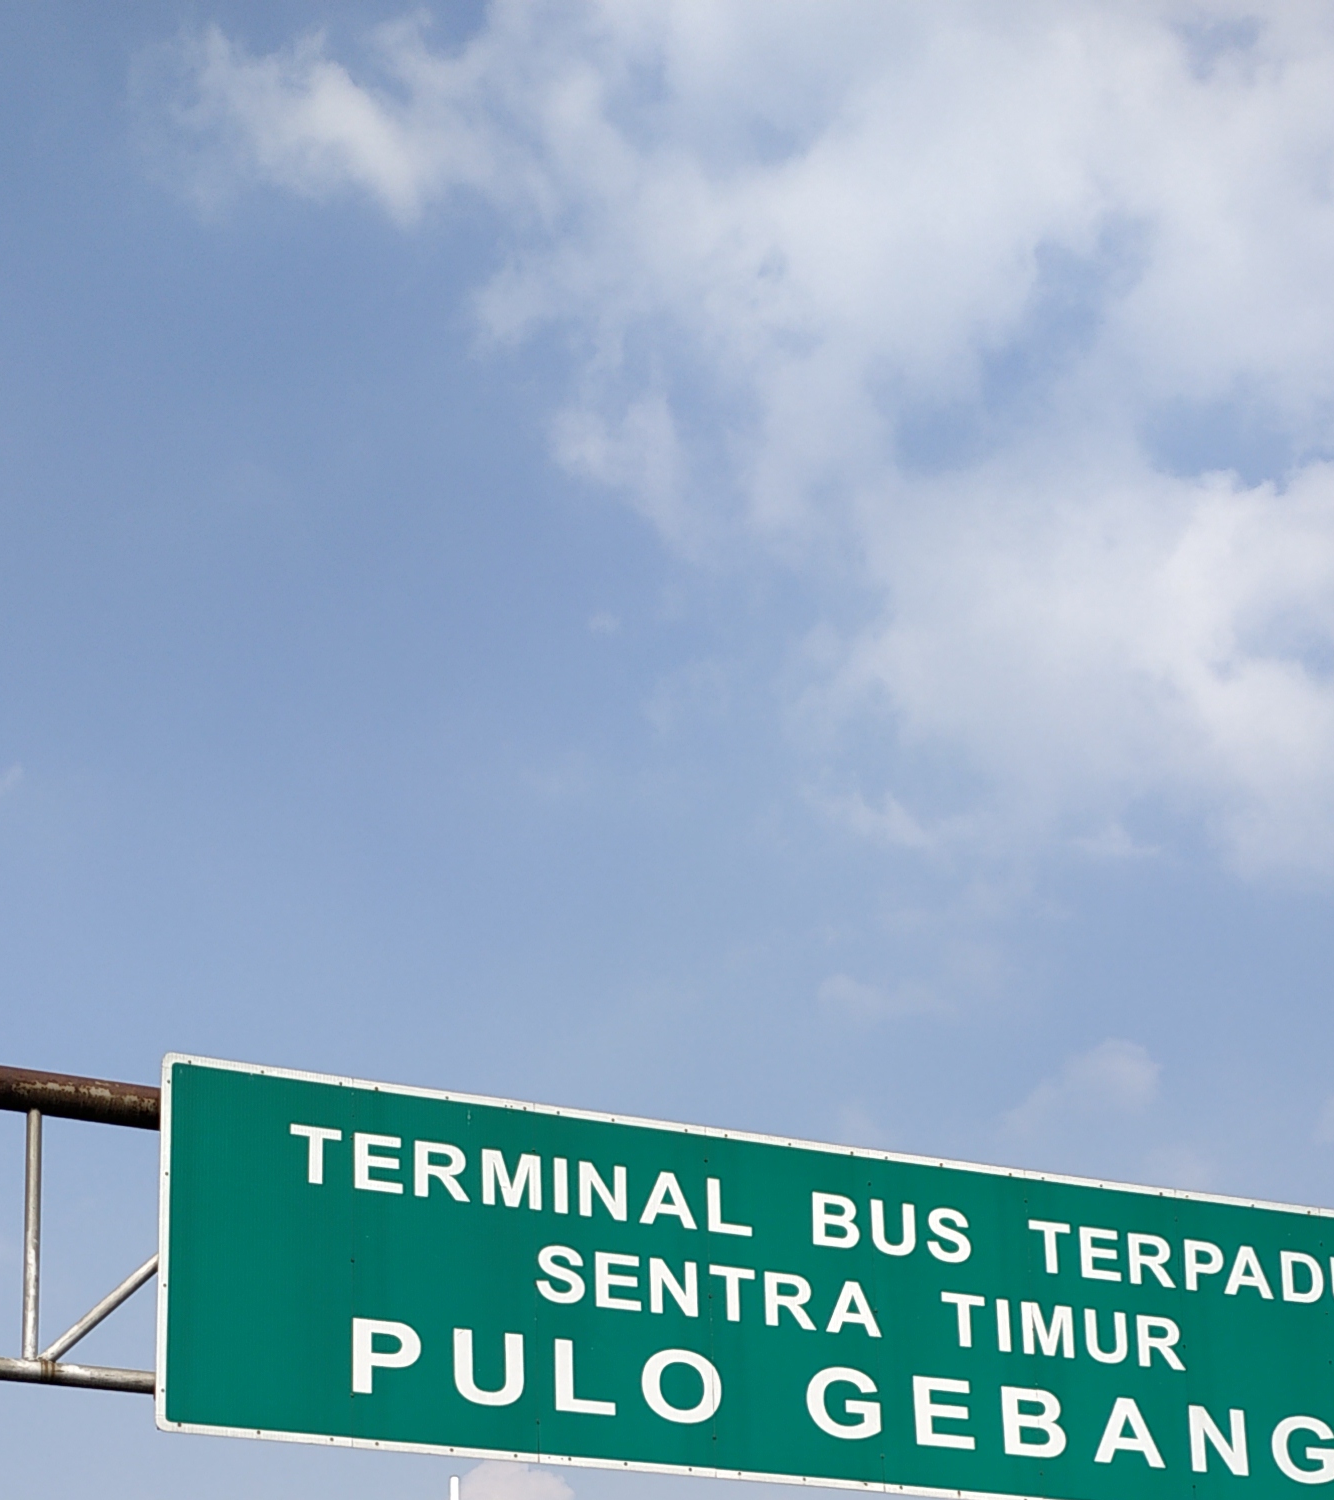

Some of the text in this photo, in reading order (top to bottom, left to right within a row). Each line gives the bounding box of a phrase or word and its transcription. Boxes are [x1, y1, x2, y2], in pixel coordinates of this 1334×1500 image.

[289, 1123, 753, 1238] TERMINAL
[811, 1190, 972, 1264] BUS
[351, 1316, 723, 1425] PULO
[535, 1244, 1186, 1371] SENTRA TIMUR
